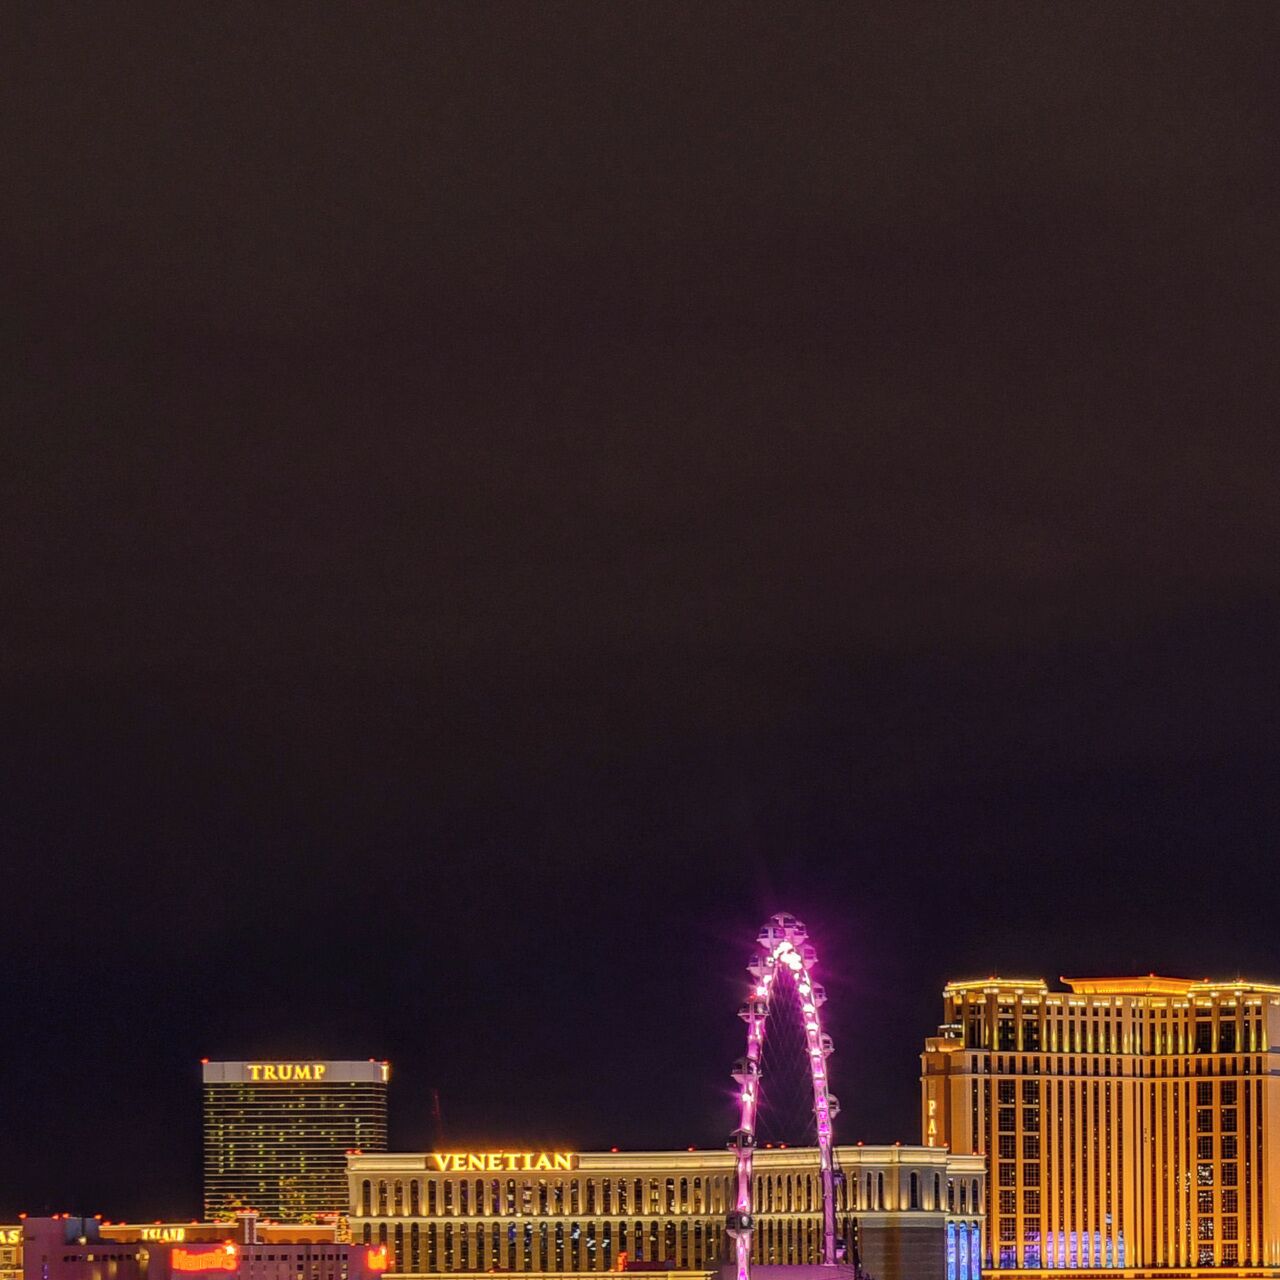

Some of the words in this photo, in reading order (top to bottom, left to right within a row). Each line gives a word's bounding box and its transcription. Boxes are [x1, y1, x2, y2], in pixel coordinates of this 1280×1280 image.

[247, 1064, 326, 1081] TRUMP
[433, 1152, 573, 1171] VENETIAN
[141, 1227, 185, 1242] ISLAND
